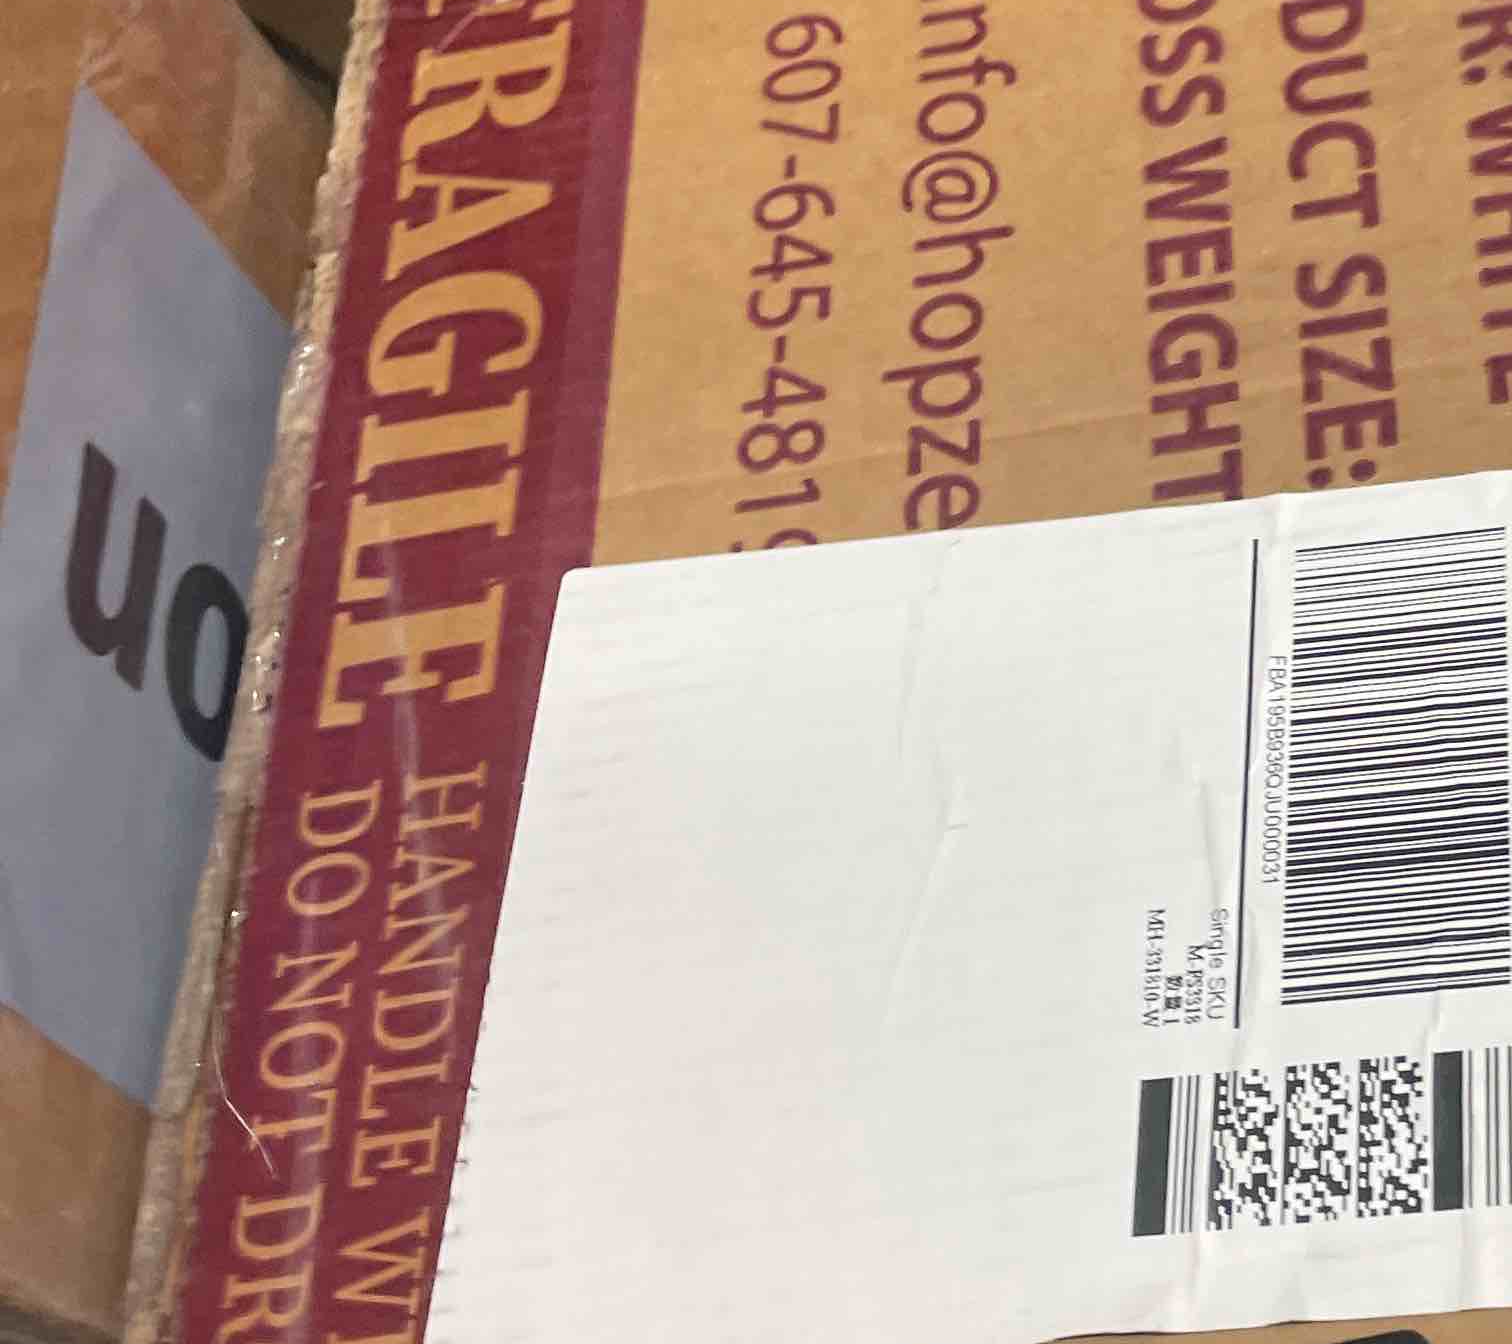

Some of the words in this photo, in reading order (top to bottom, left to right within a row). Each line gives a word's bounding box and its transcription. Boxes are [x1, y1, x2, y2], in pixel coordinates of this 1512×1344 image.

[1141, 137, 1243, 504] WEIGHT
[1297, 254, 1398, 489] SIZE:
[284, 779, 382, 917] DO
[1205, 908, 1228, 969] Single
[247, 941, 360, 1157] NOT
[346, 761, 487, 1189] HANDLE
[1206, 977, 1225, 1019] SKU
